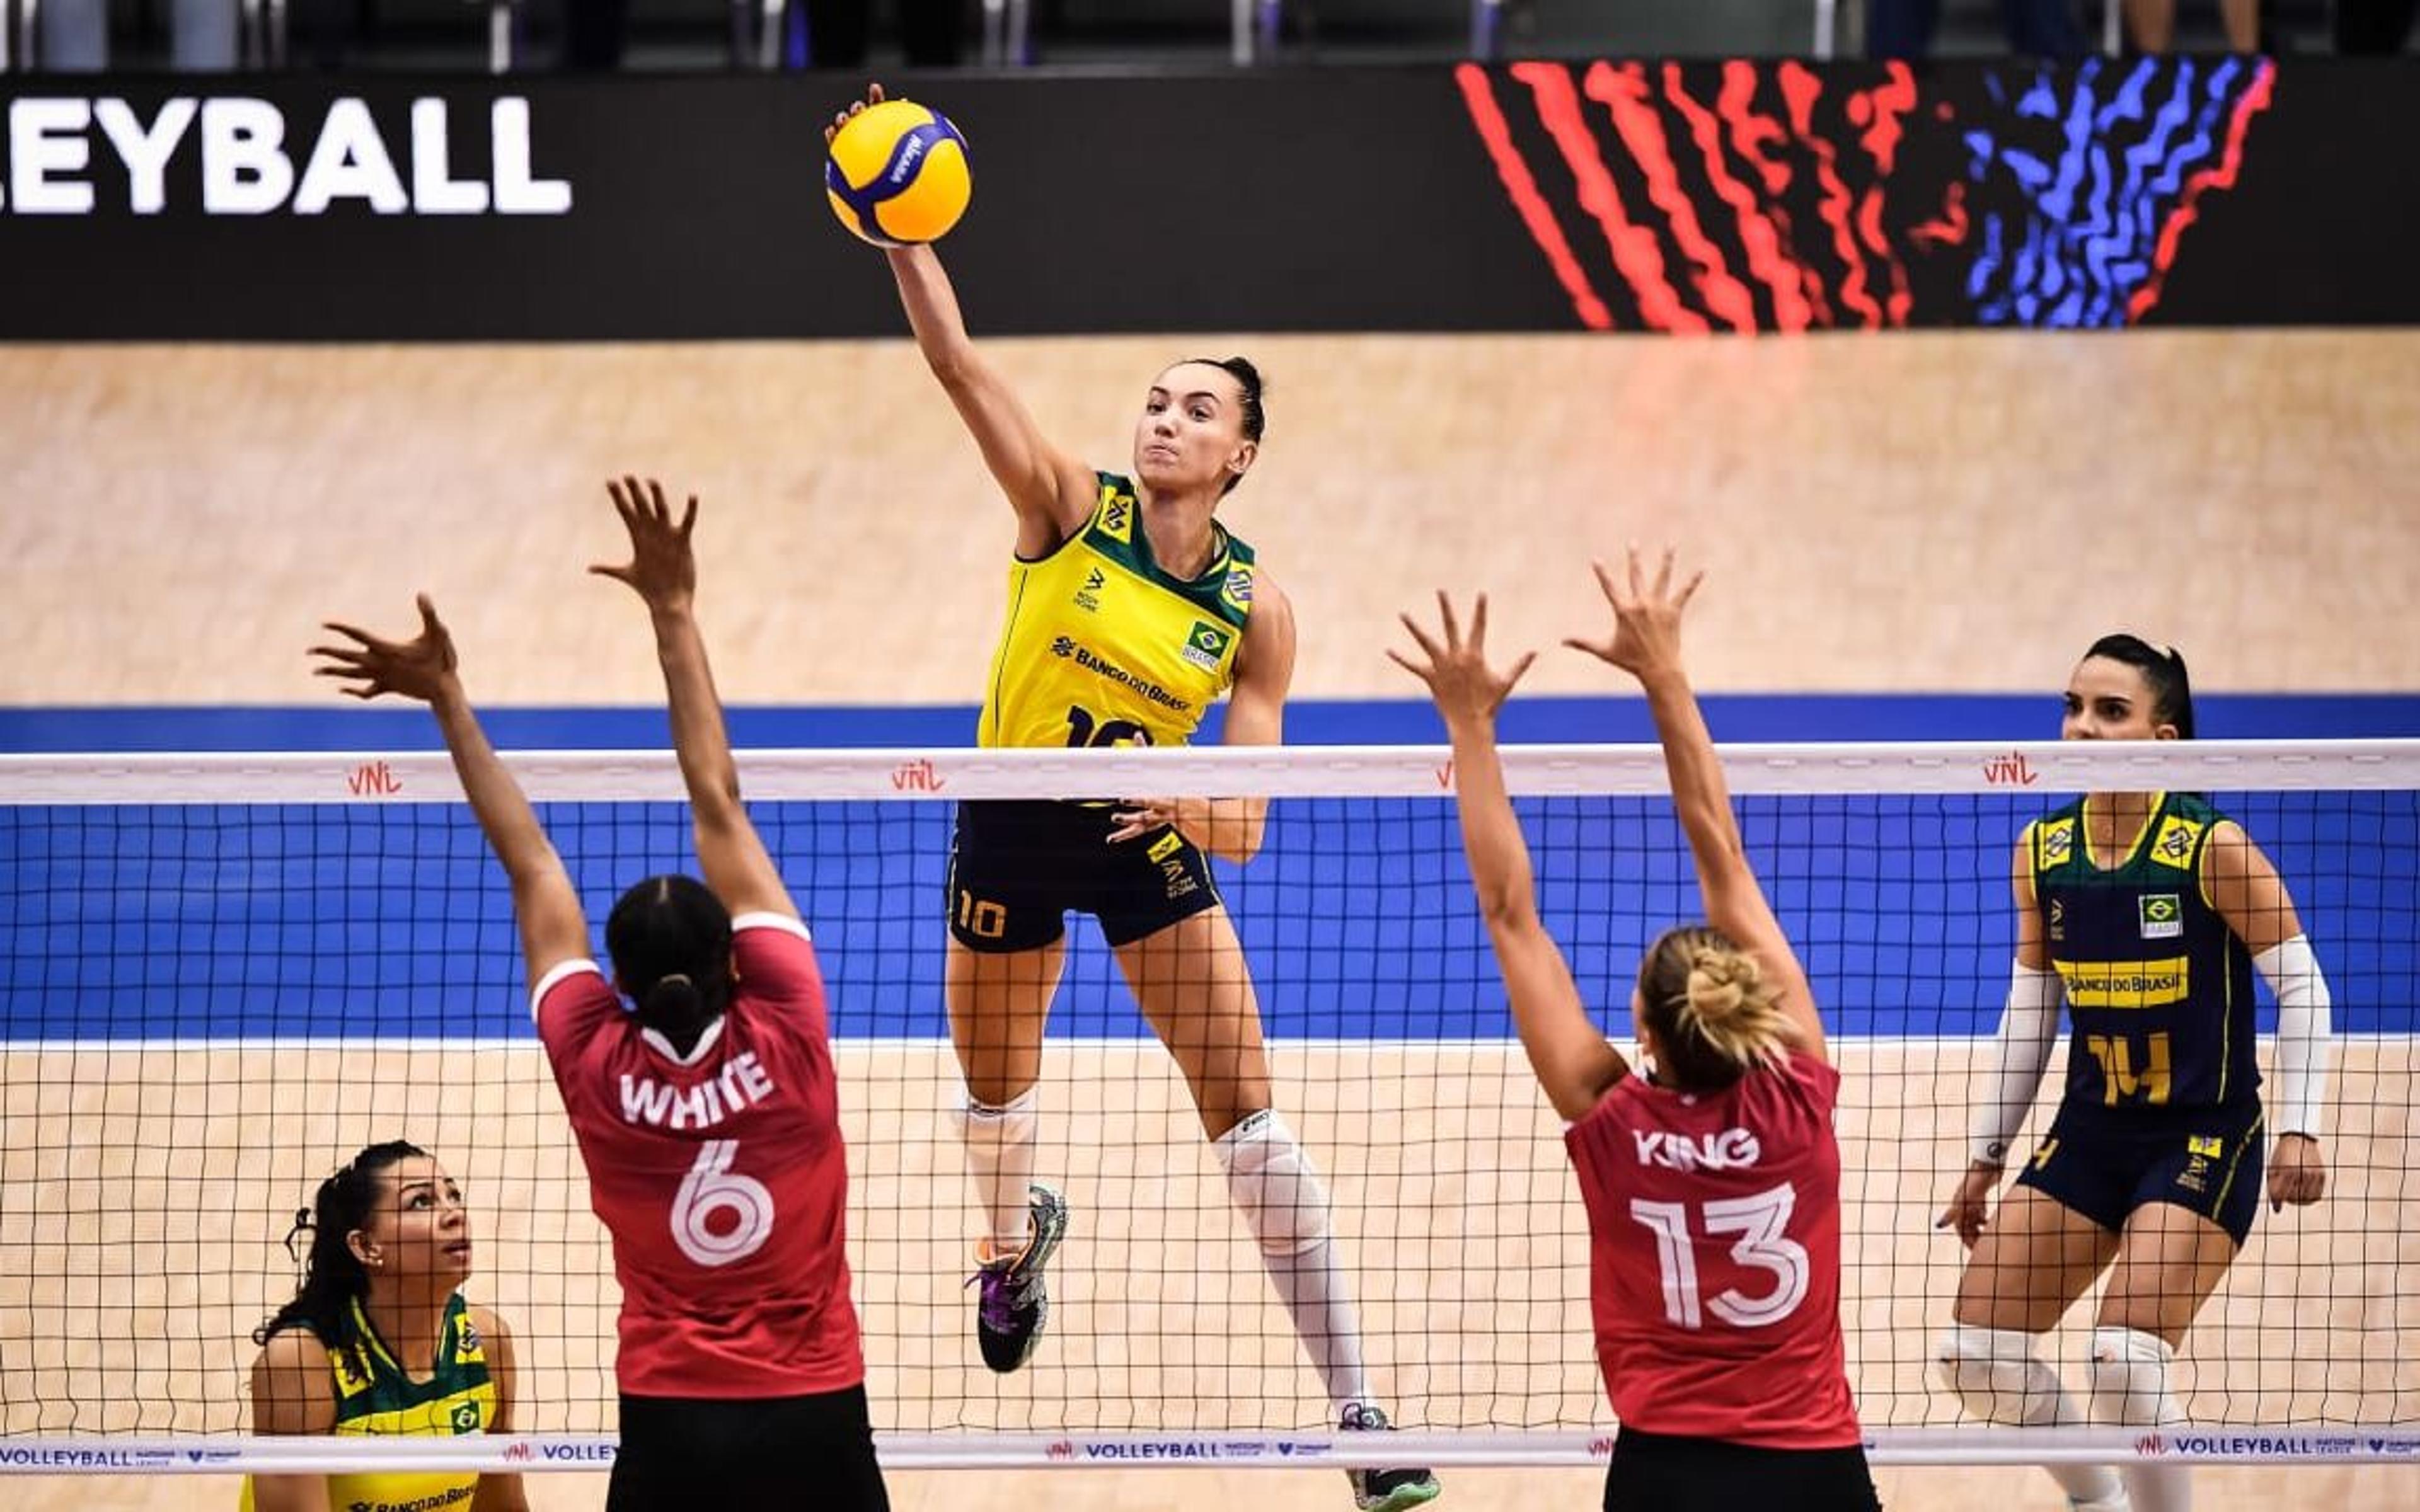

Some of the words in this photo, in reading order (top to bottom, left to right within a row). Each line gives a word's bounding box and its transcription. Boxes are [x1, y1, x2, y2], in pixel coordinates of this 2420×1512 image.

[0, 97, 572, 215] EYBALL
[1076, 648, 1129, 683] BANCO
[959, 889, 1006, 938] 10
[620, 1051, 775, 1130] WHITE
[2087, 1032, 2171, 1106] 14
[1632, 1127, 1761, 1174] KING
[669, 1139, 775, 1267] 6
[1629, 1180, 1810, 1329] 13
[0, 1448, 132, 1467] VOLLEYBALL
[1085, 1443, 1220, 1458] VOLLEYBALL
[2175, 1437, 2312, 1454] VOLLEYBALL
